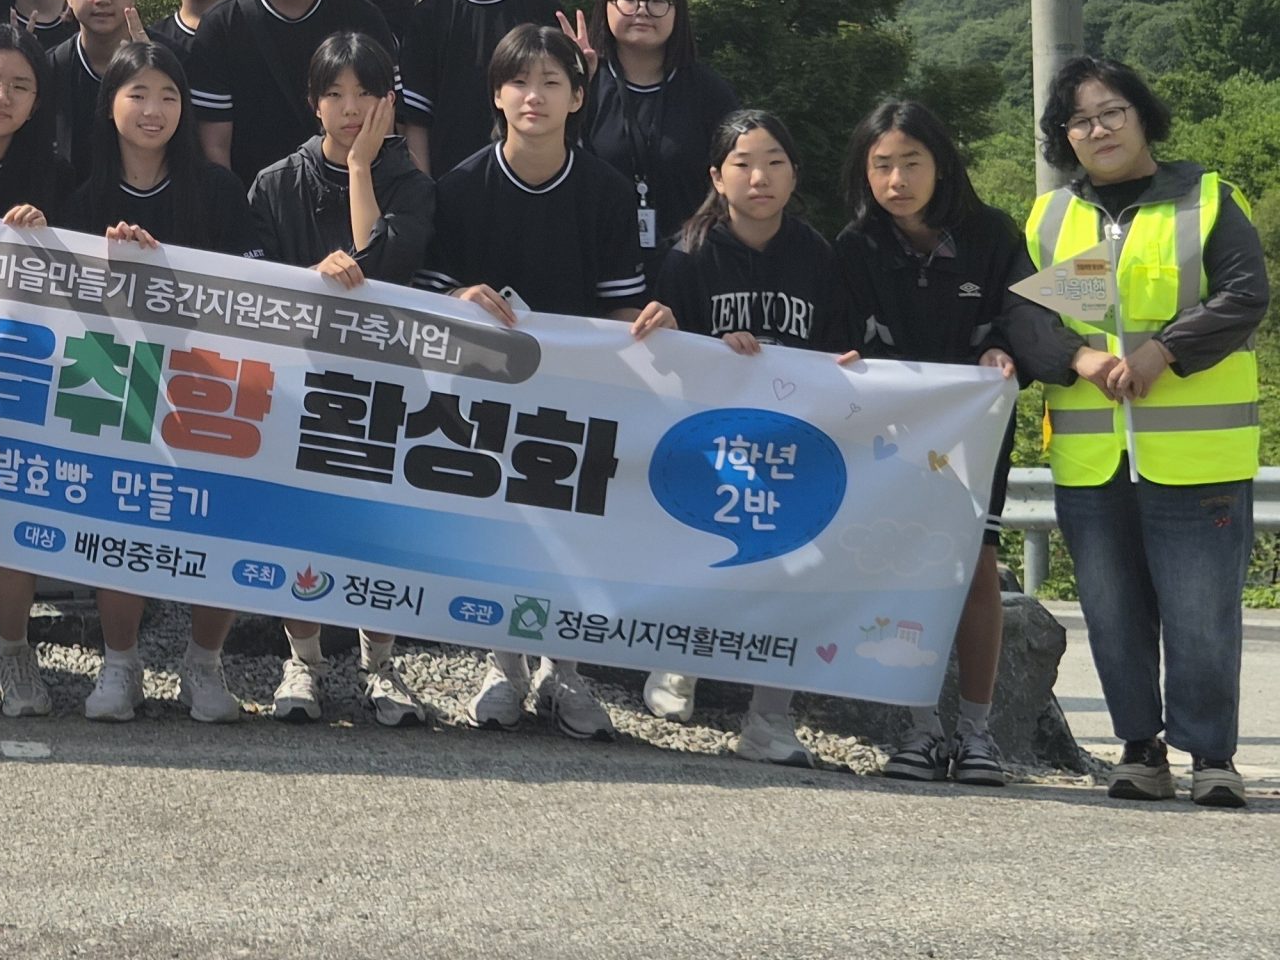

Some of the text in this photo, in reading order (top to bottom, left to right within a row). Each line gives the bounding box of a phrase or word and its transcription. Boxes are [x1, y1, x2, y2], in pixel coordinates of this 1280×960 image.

[145, 277, 323, 339] 중간지원조직
[296, 370, 619, 516] 활성화
[713, 433, 797, 481] 1학년
[111, 470, 208, 521] 만들기
[714, 484, 780, 530] 2반
[24, 525, 56, 548] 대상
[74, 531, 207, 579] 배영중학교
[242, 563, 275, 586] 주최
[342, 574, 424, 616] 정읍시
[459, 601, 494, 623] 주관
[555, 609, 798, 666] 정읍시지역활력센터
